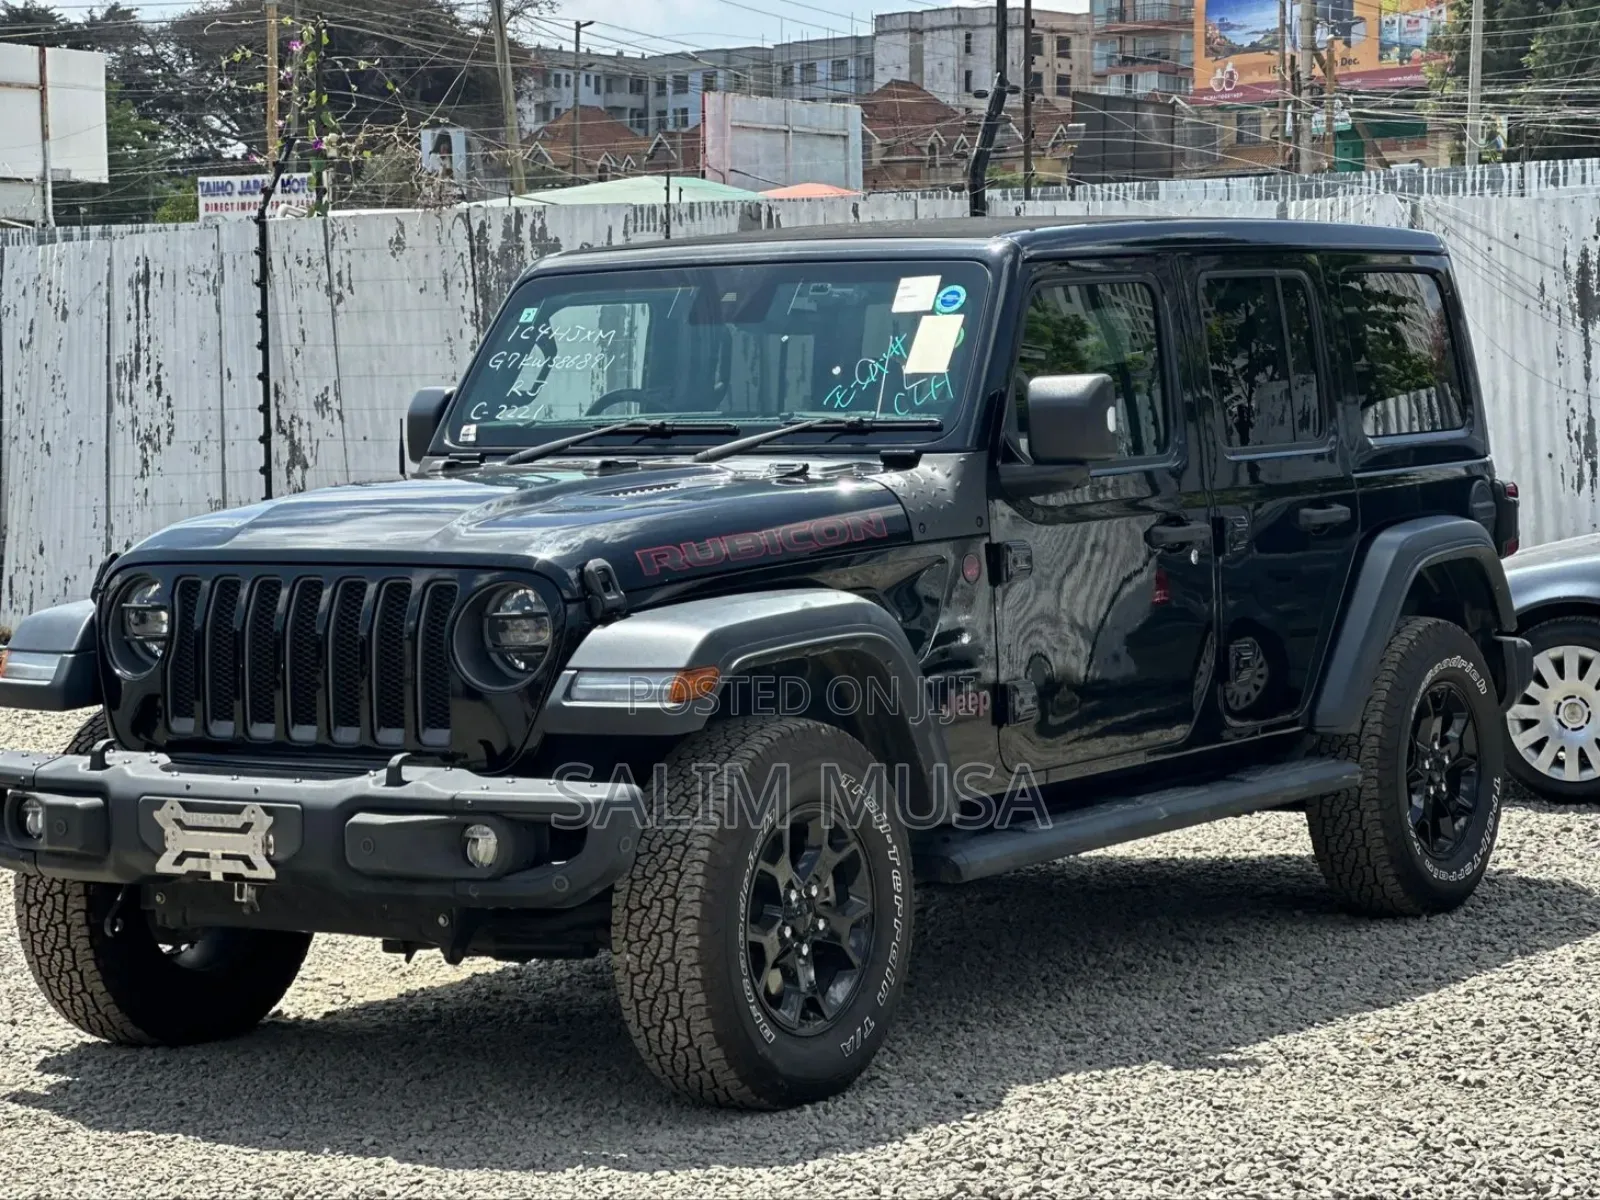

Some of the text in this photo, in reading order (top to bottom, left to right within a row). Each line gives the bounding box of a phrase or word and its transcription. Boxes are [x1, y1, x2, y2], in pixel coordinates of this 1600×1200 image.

[1340, 57, 1360, 67] Dec.
[205, 201, 234, 212] DIRECT
[237, 201, 262, 212] IMPO
[635, 512, 888, 577] RUBICON
[942, 688, 991, 718] Jeep
[840, 773, 904, 1007] Trail-Terrain
